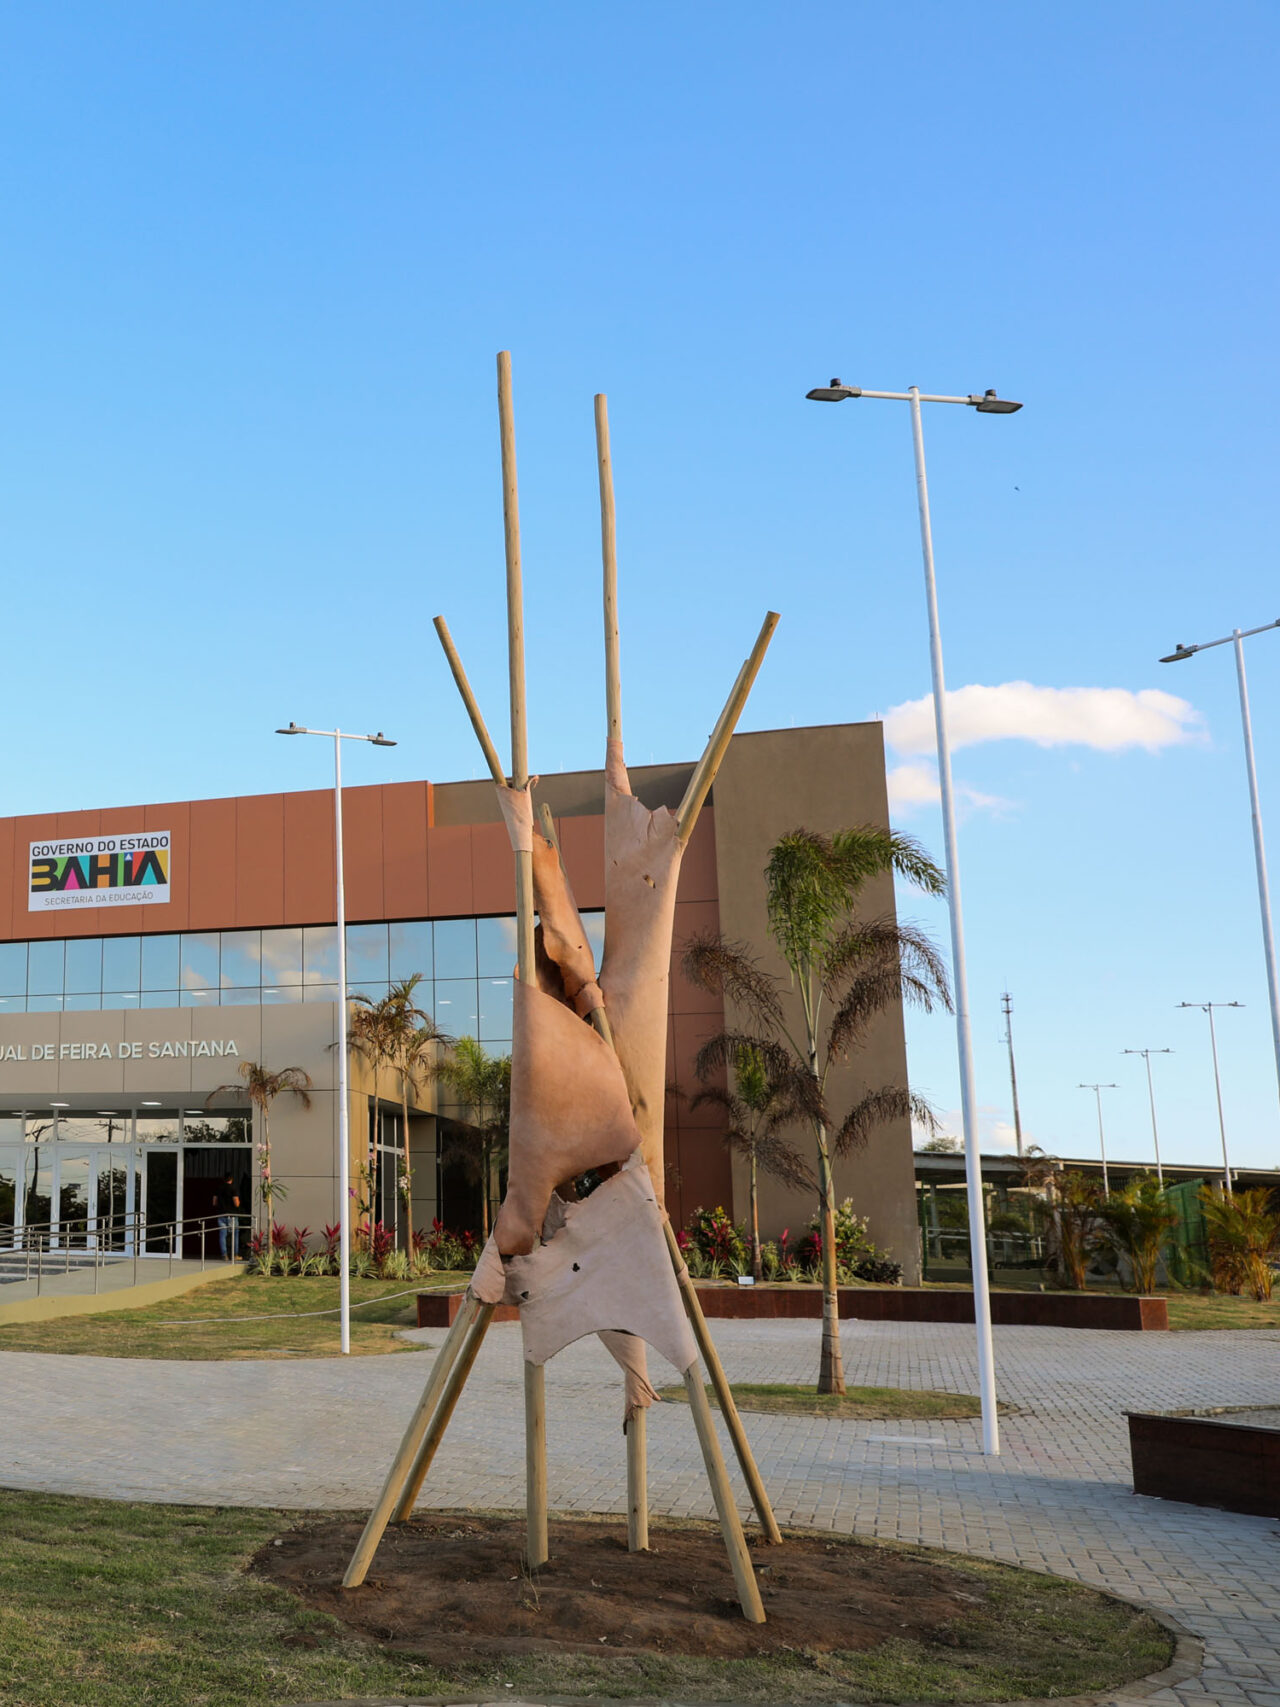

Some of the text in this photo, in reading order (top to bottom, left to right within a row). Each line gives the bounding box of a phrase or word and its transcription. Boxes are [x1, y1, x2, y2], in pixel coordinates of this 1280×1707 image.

[32, 836, 169, 857] GOVERNO DO ESTADO
[31, 850, 168, 892] BAHIA
[44, 891, 154, 906] SECRETARIA DA EDUCAÇÃO
[31, 1044, 55, 1060] DE
[59, 1043, 112, 1060] FEIRA
[119, 1042, 143, 1059] DE
[148, 1040, 239, 1058] SANTANA
